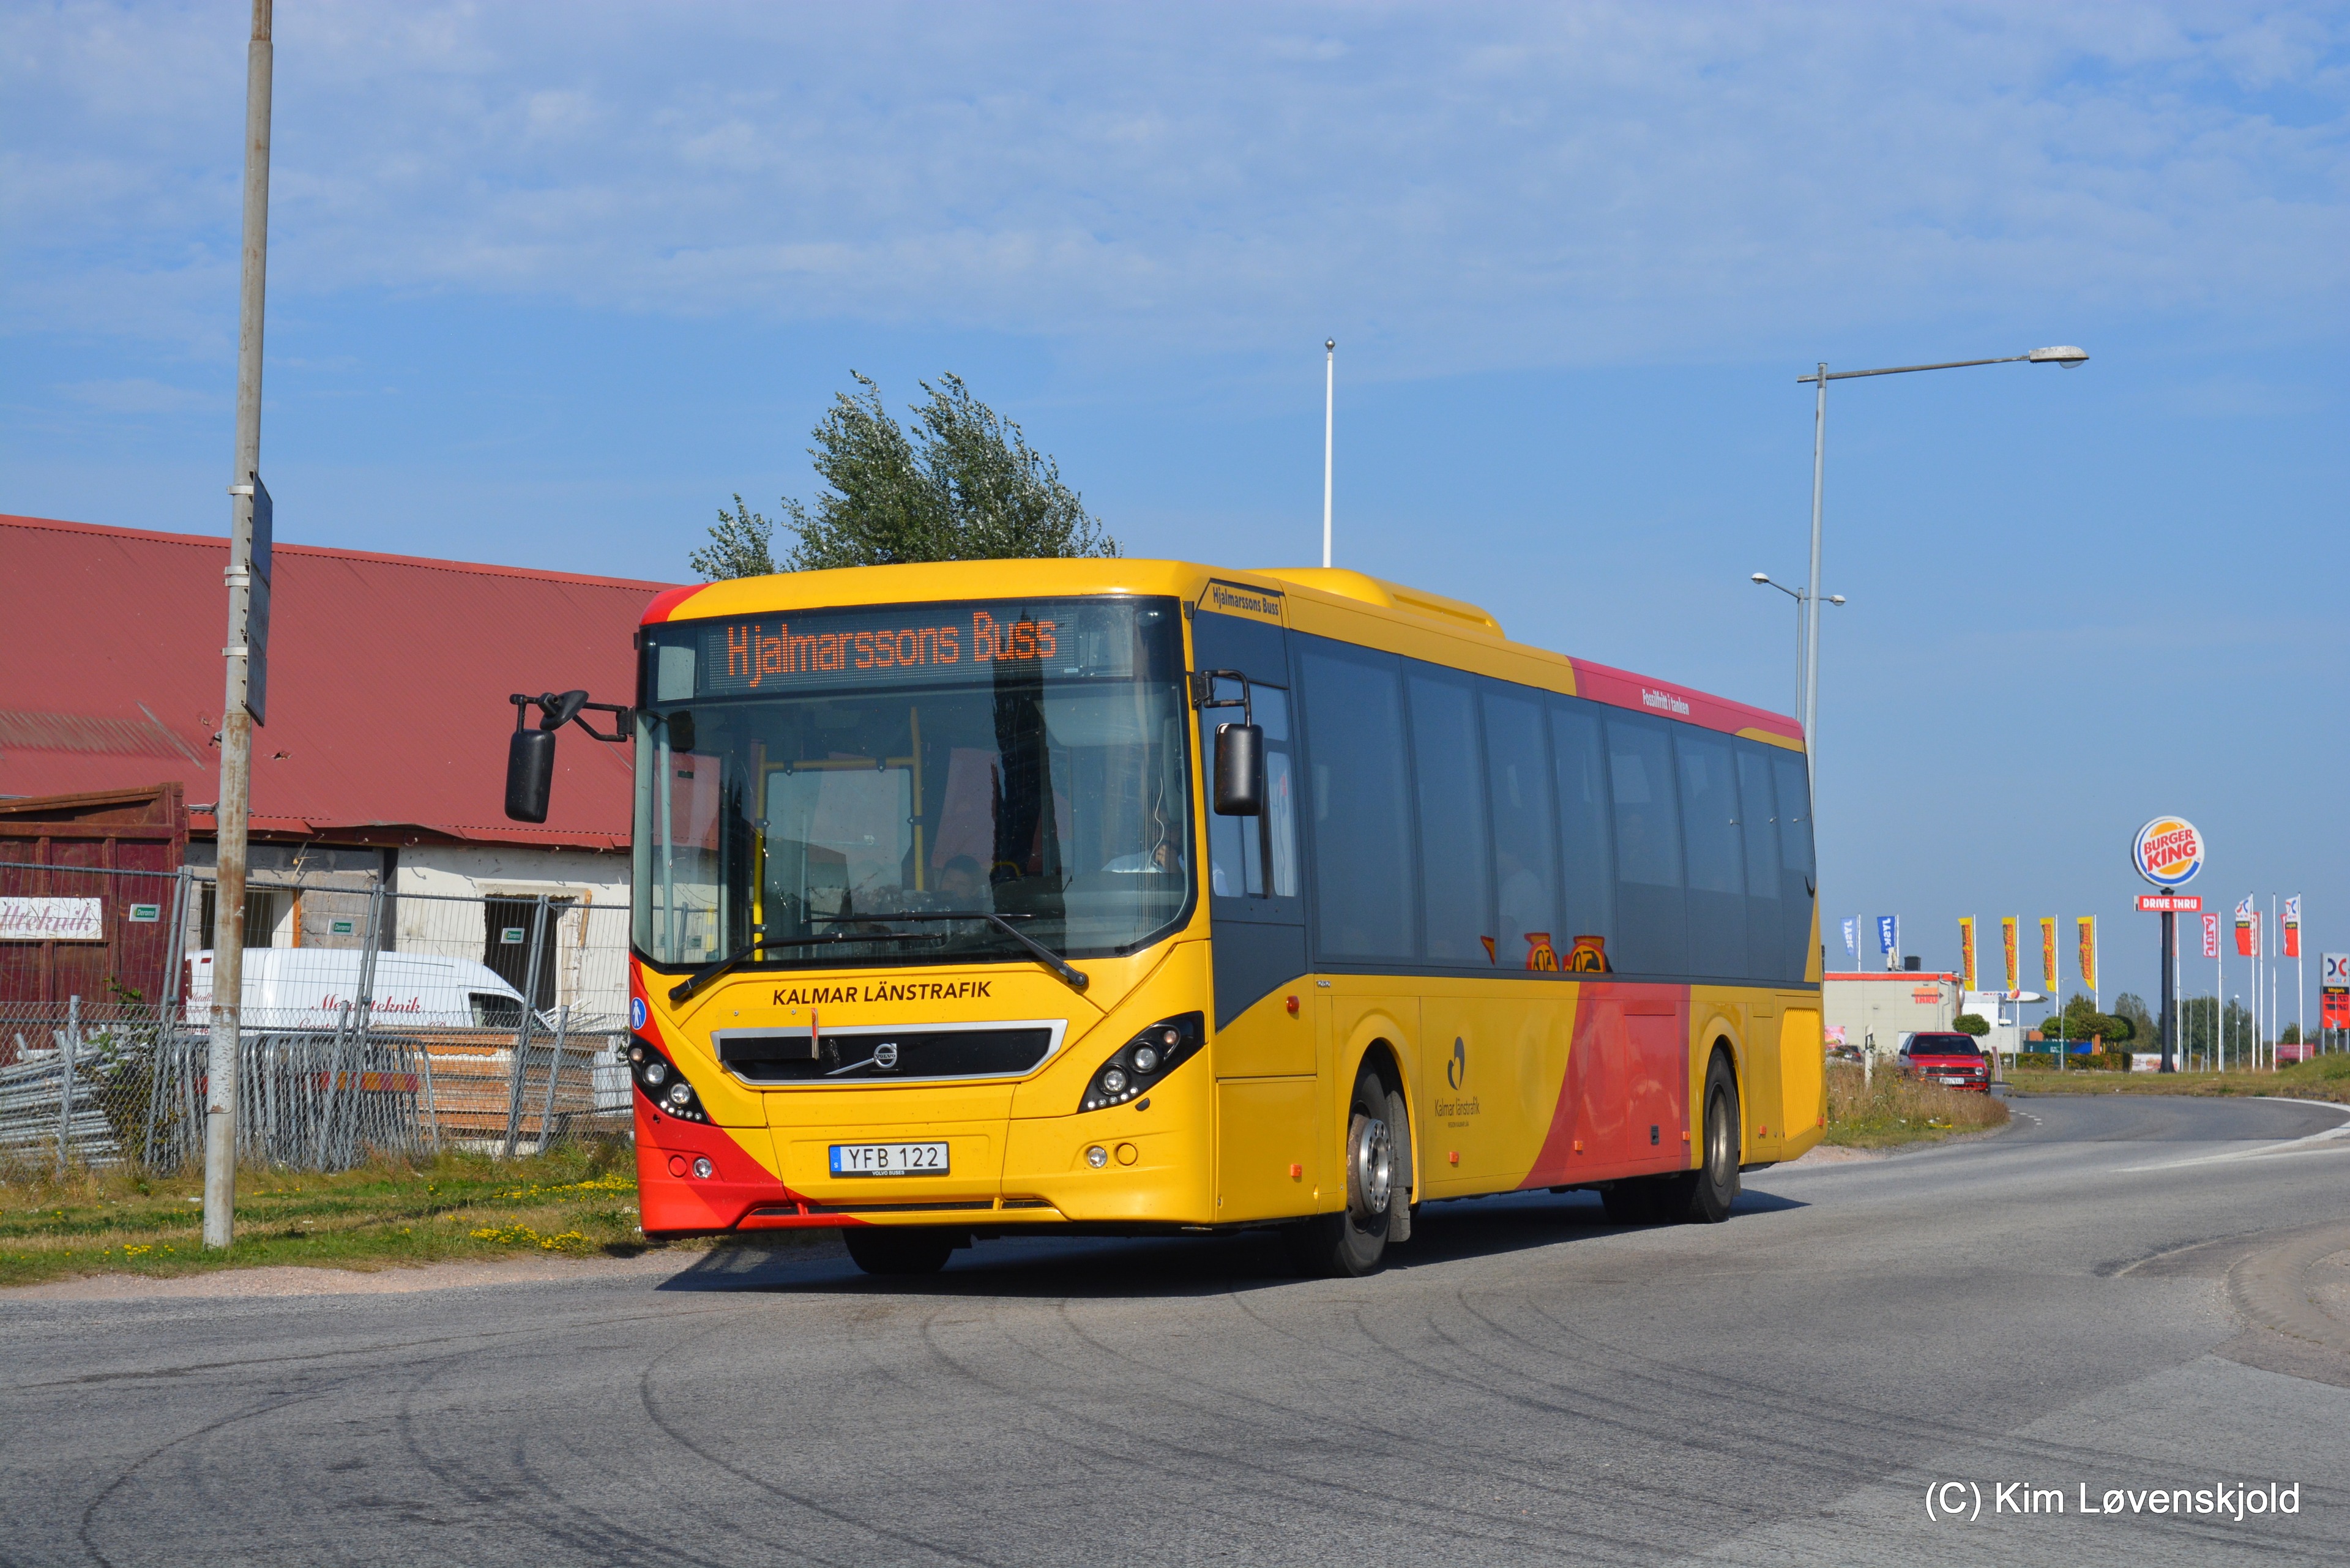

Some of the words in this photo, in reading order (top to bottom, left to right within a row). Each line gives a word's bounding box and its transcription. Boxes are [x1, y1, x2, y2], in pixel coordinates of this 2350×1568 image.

[1213, 586, 1261, 612] Hjalmarssons
[1263, 597, 1278, 616] Buss
[728, 623, 959, 687] Hjalmarssons
[973, 611, 1056, 662] Buss
[1642, 689, 1668, 710] Fossilfritt
[1667, 693, 1671, 711] i
[1671, 696, 1689, 715] tanken
[2144, 829, 2193, 856] BURGER
[2147, 840, 2196, 872] KING
[136, 908, 155, 917] Derome
[2143, 897, 2170, 908] DRIVE
[2173, 898, 2197, 909] THRU
[773, 986, 857, 1006] KALMAR
[864, 980, 992, 1002] LÄNSTRAFIK
[1434, 1097, 1454, 1116] Kalmar
[1455, 1096, 1480, 1115] länstrafik
[848, 1148, 889, 1168] YFB
[900, 1147, 938, 1167] 122
